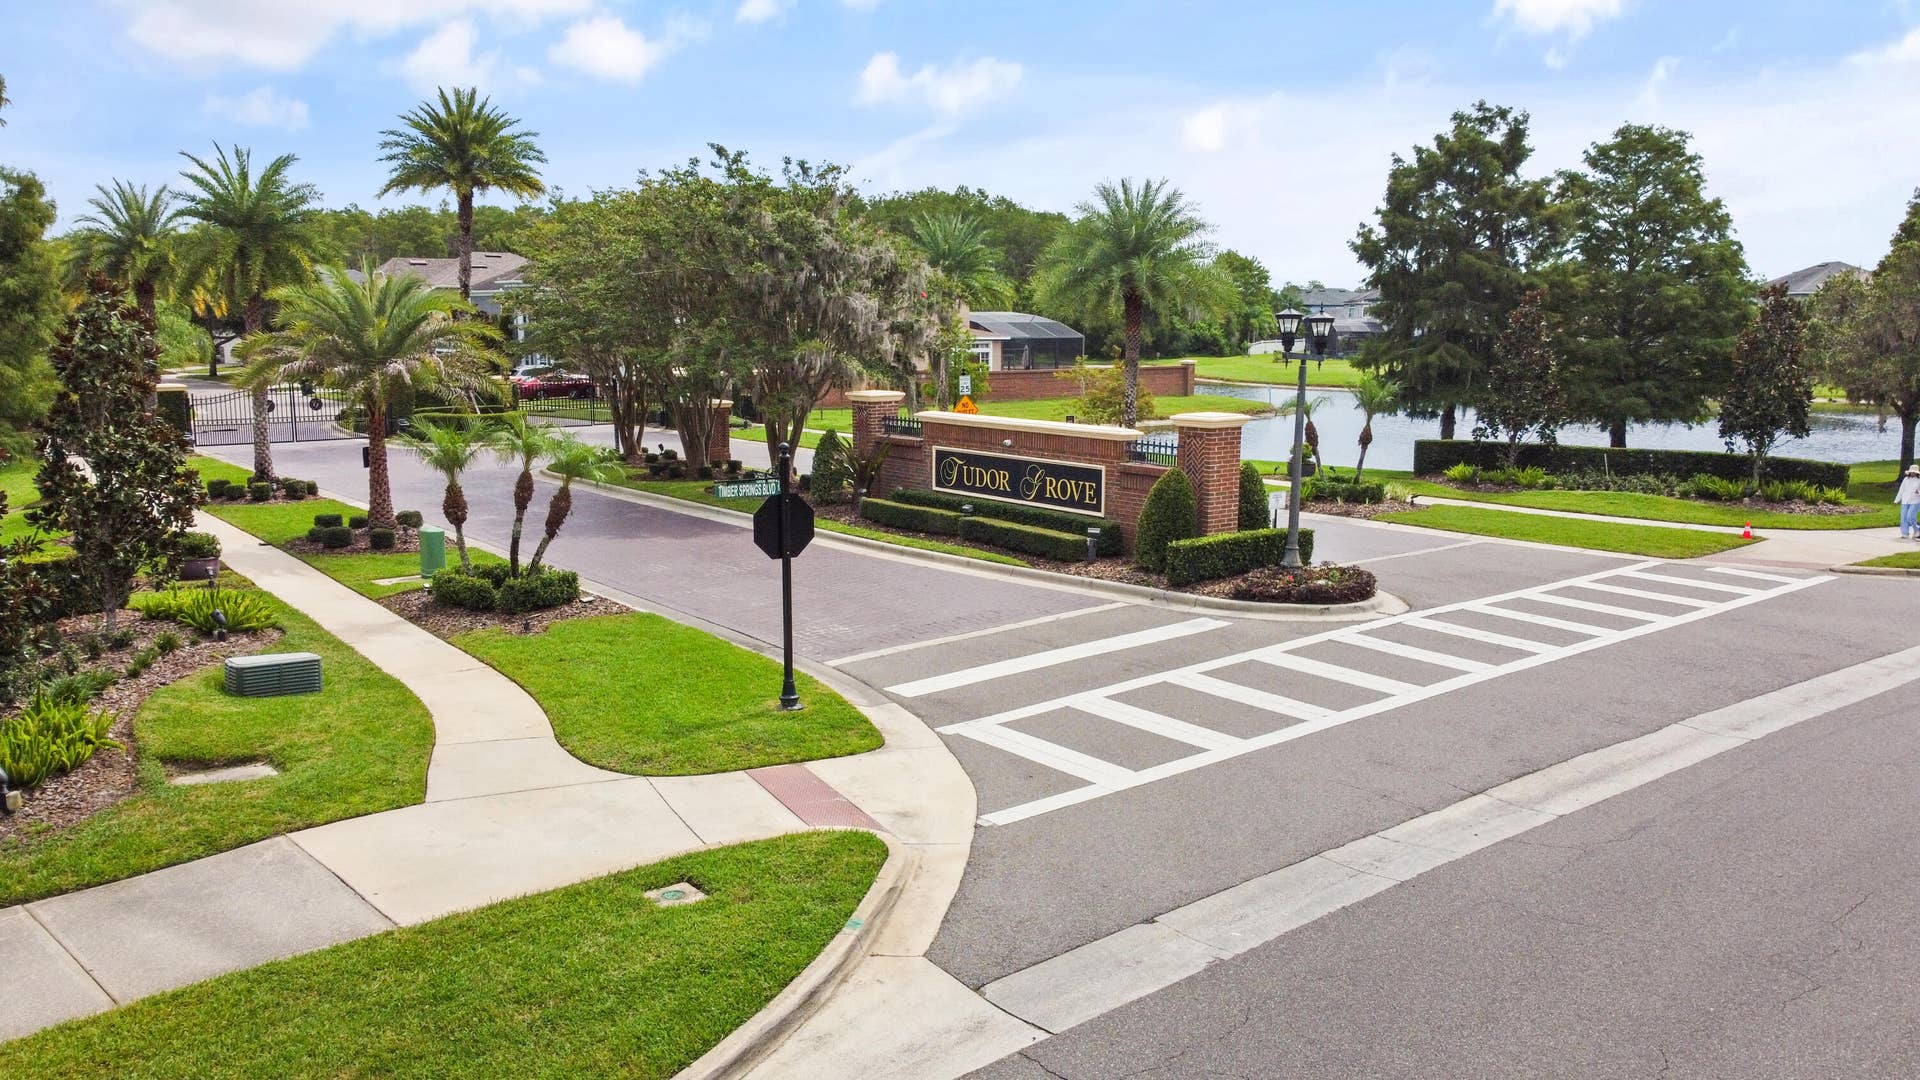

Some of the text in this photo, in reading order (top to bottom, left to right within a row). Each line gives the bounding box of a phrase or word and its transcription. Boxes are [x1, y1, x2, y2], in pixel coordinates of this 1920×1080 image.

[718, 486, 738, 498] TIMBER
[739, 484, 762, 496] SPRINGS
[763, 483, 776, 495] BLVD
[940, 457, 1096, 504] TUDOR GROVE
